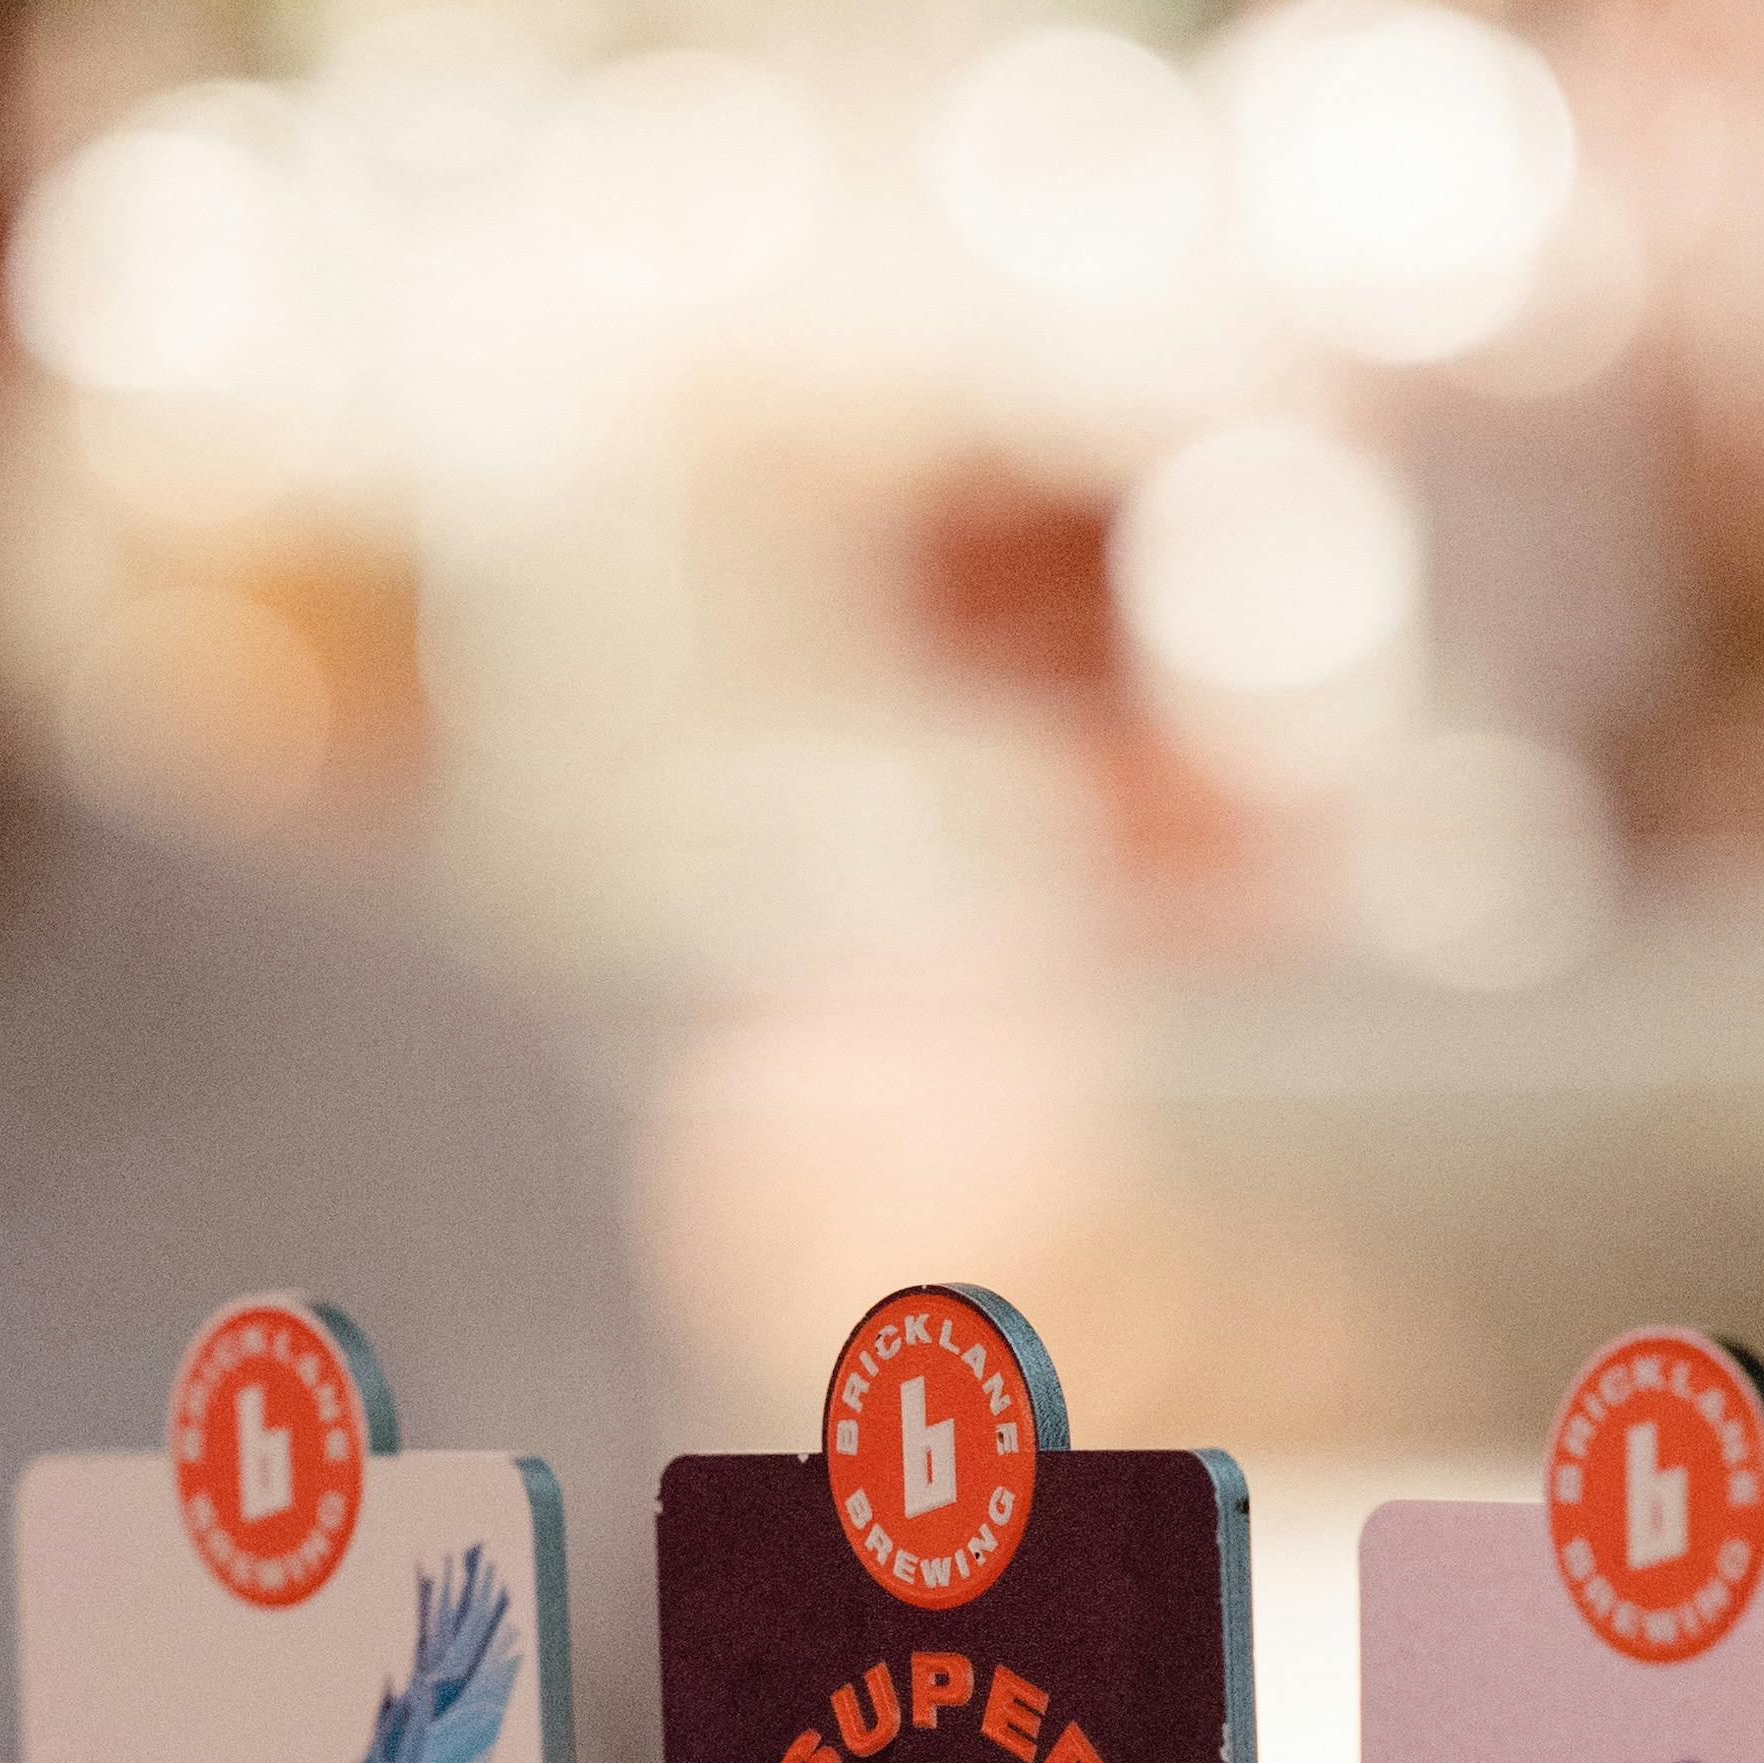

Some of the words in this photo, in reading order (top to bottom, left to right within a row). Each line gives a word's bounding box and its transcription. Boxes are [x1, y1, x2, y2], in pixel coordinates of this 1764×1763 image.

[238, 1385, 293, 1522] b
[900, 1376, 957, 1520] b
[1626, 1421, 1690, 1572] b
[845, 1486, 1016, 1589] BREWING
